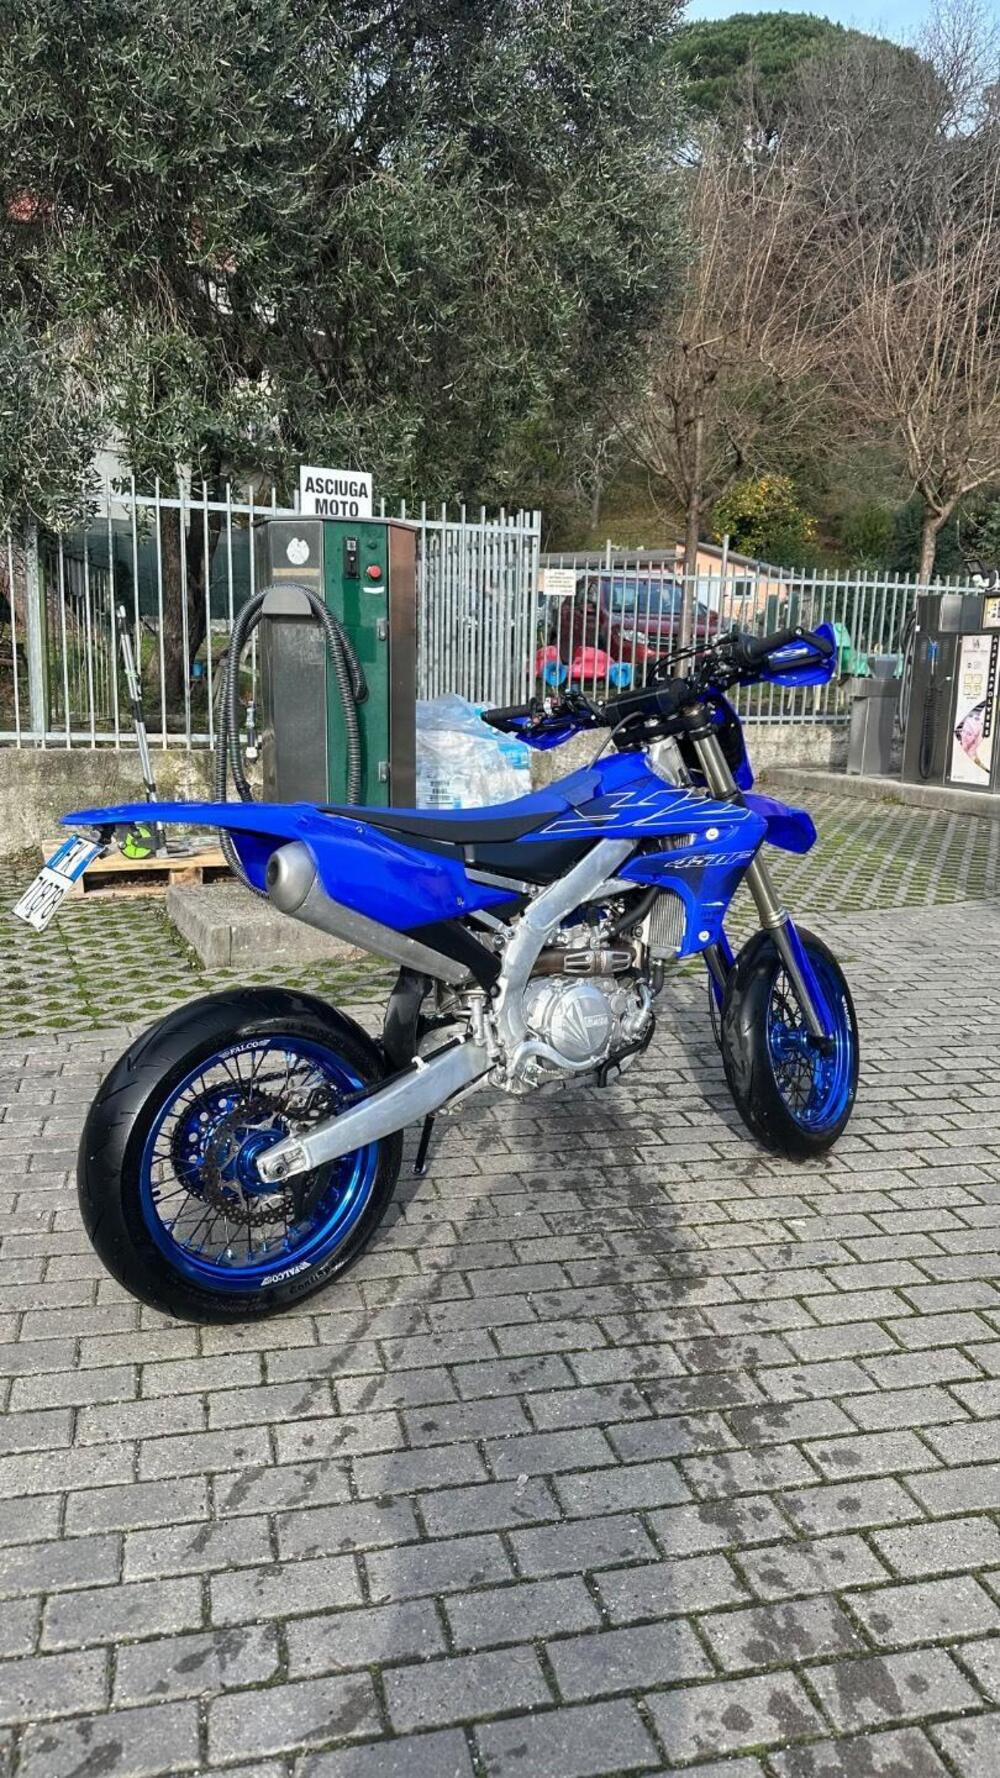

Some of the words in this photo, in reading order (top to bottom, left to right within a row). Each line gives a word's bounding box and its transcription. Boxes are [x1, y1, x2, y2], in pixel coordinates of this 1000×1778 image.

[304, 476, 369, 498] ASCIUGA
[314, 498, 359, 516] MOTO
[230, 1041, 260, 1055] FALCO
[272, 1265, 301, 1282] FALCO
